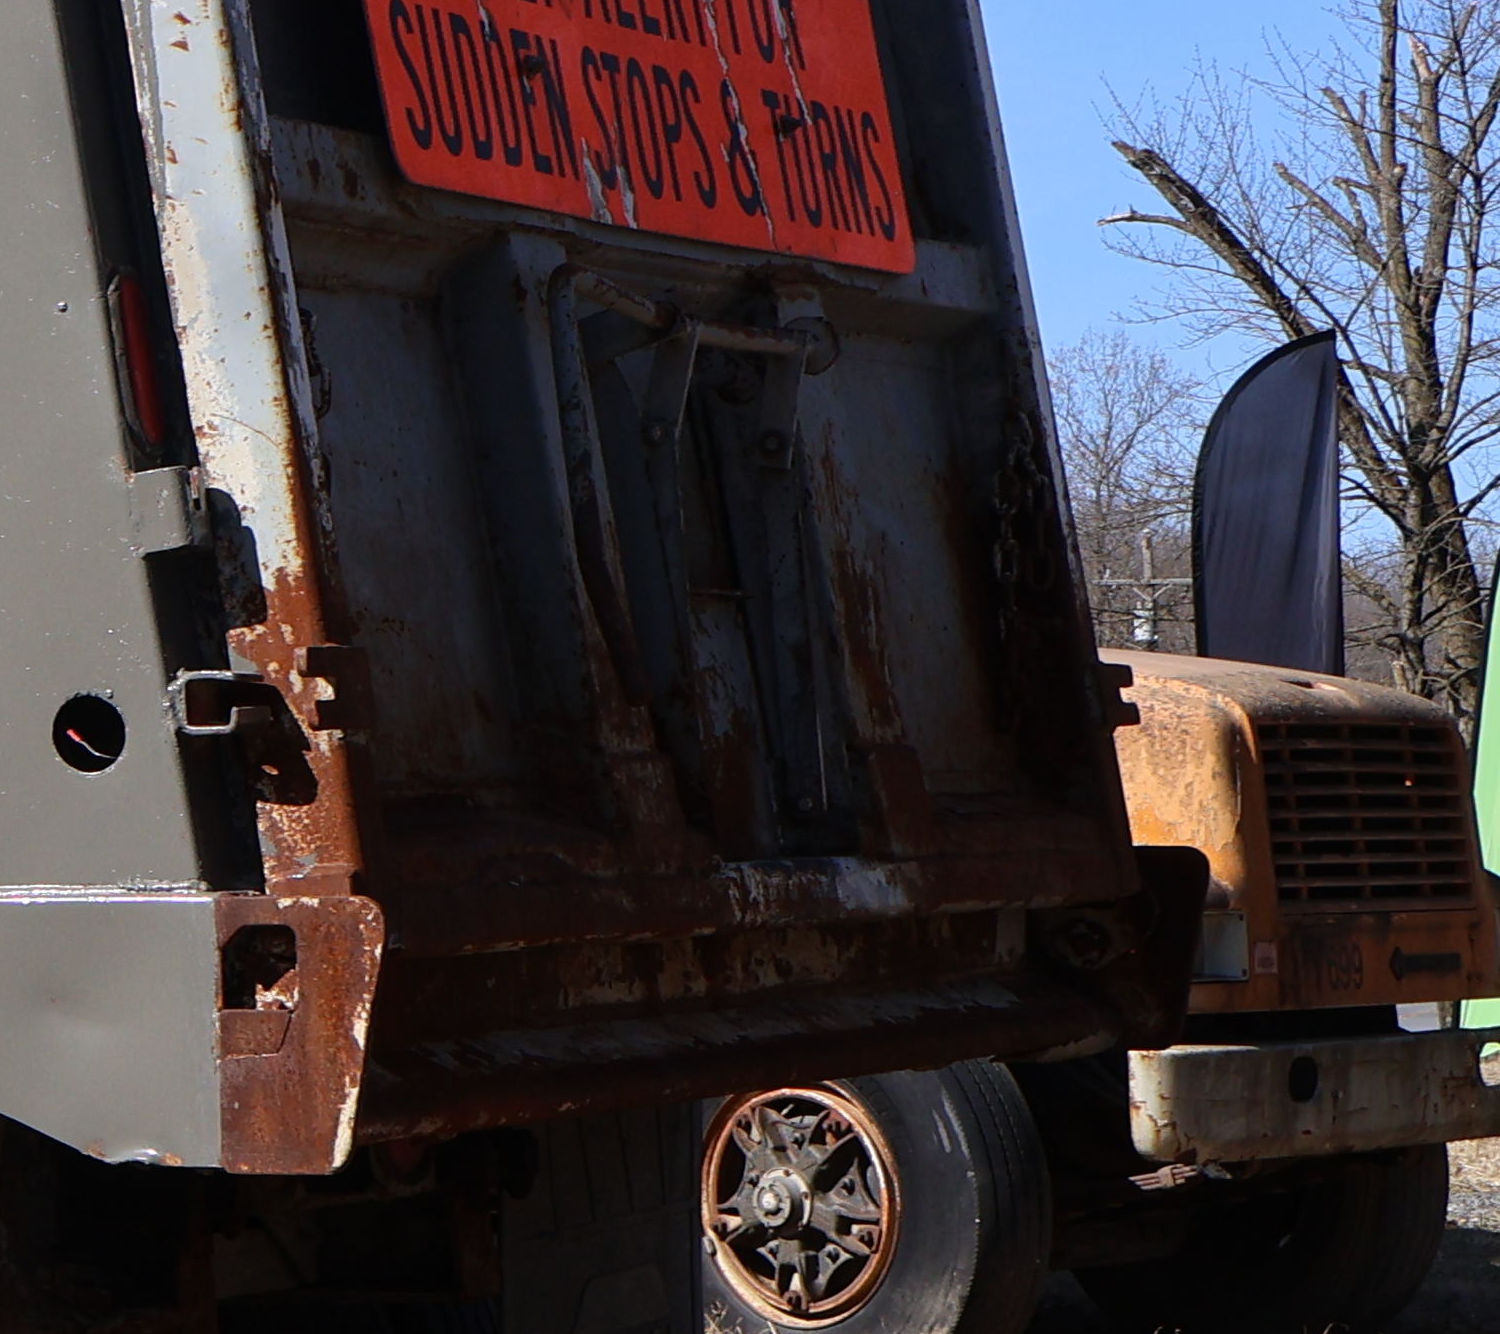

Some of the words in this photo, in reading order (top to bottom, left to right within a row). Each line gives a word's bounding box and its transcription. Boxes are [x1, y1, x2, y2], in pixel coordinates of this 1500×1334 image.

[581, 51, 718, 208] STOPS
[721, 78, 761, 216] &
[762, 91, 896, 242] TURNS
